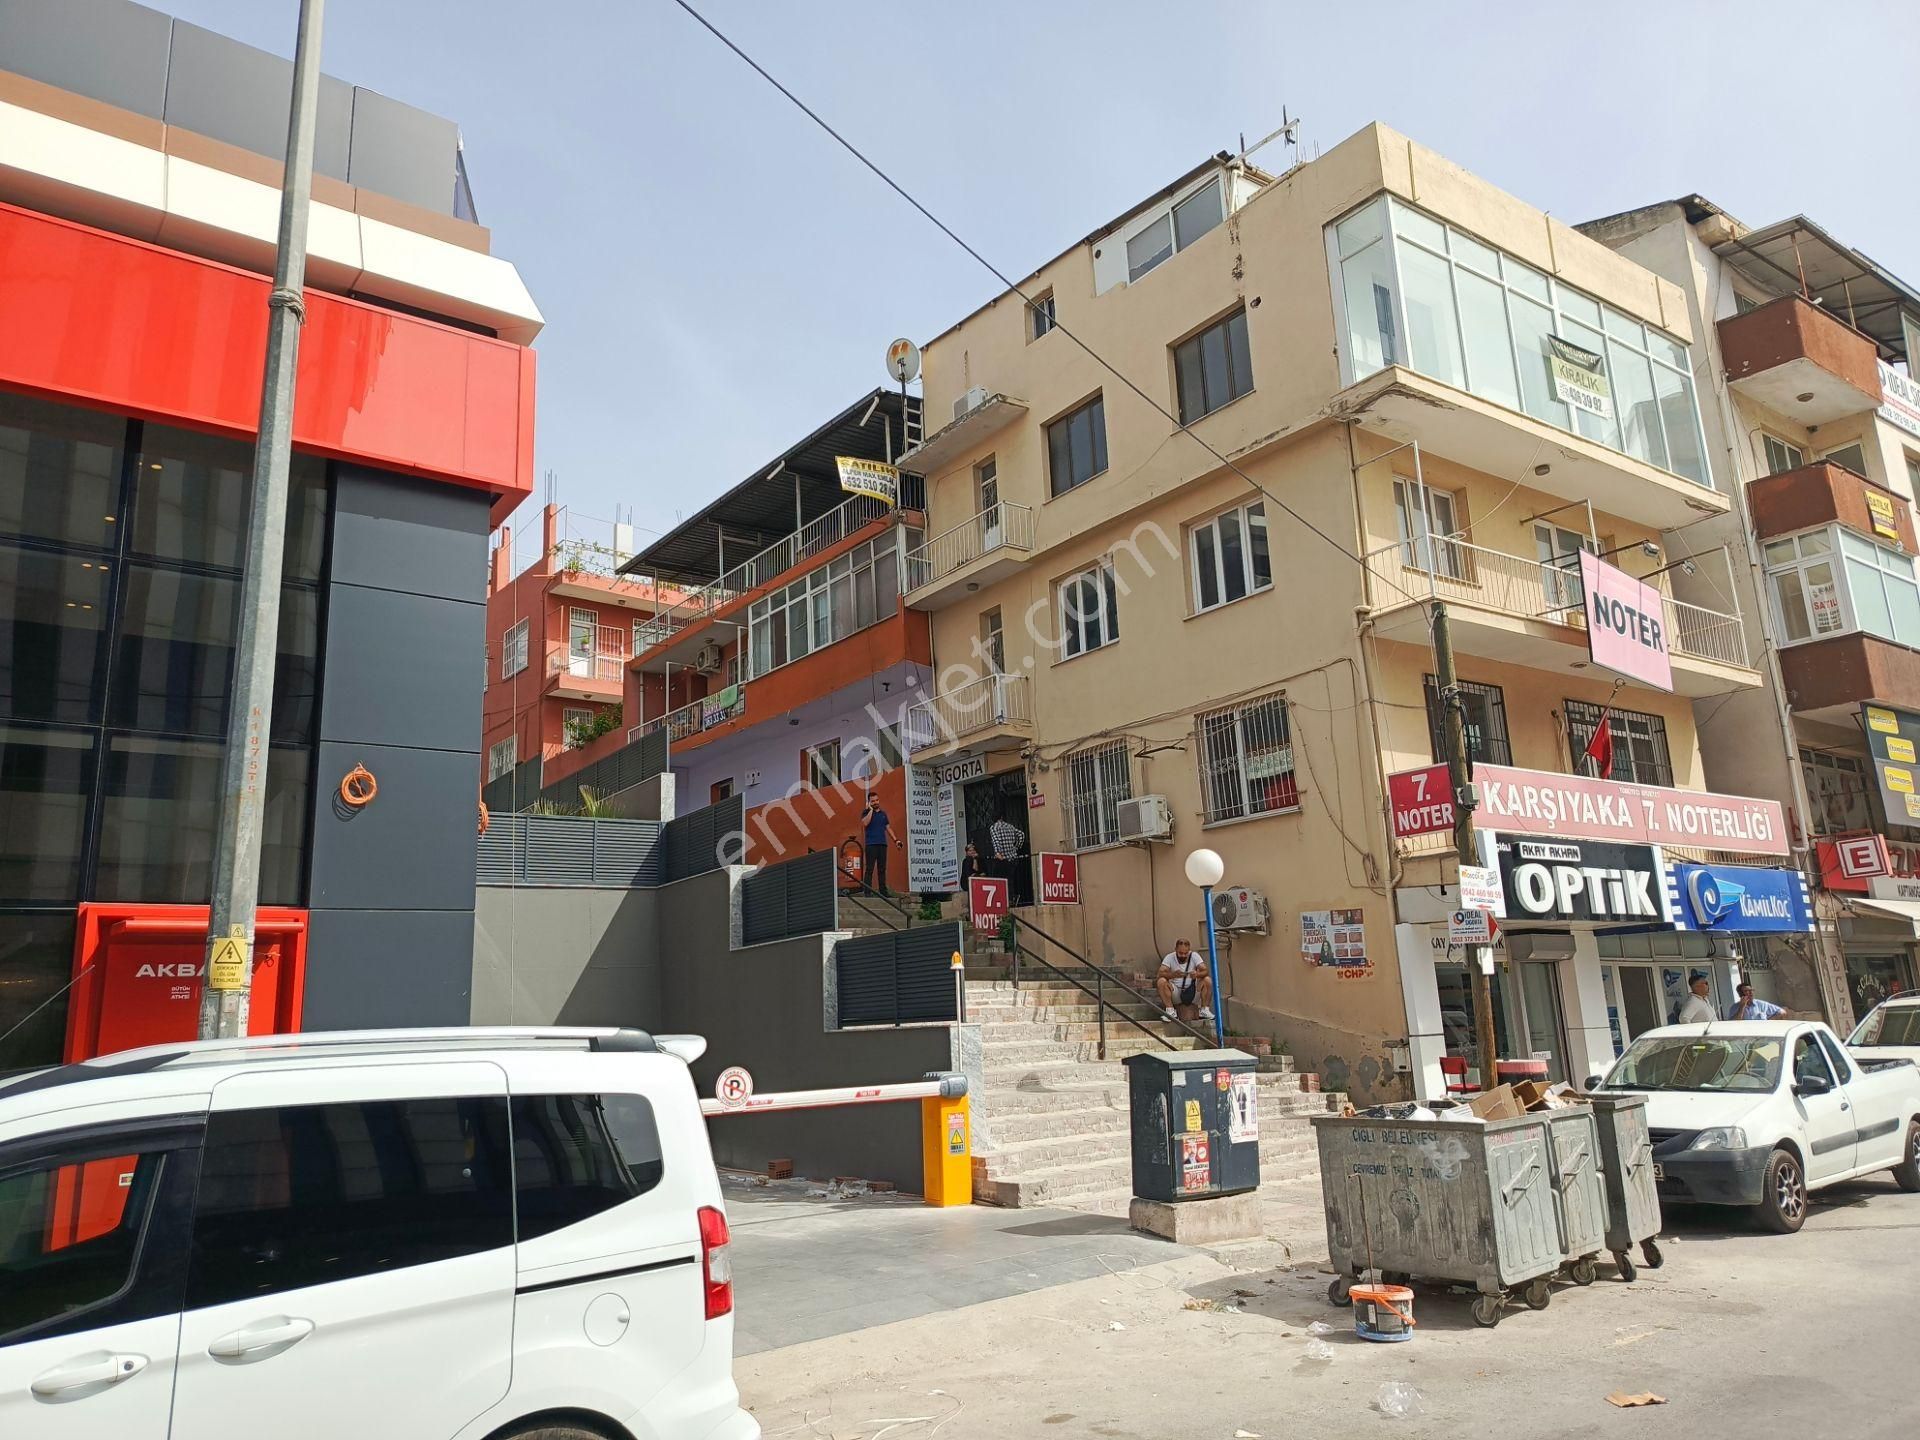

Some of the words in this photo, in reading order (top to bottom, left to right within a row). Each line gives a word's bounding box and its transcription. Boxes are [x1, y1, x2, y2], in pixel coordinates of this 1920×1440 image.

[1813, 600, 1838, 611] SATIL
[1593, 591, 1664, 653] NOTER
[1411, 773, 1431, 802] 7.
[1398, 803, 1454, 832] NOTER
[1482, 780, 1633, 829] KARŞIYAKA
[1643, 799, 1660, 831] 7.
[1664, 802, 1773, 841] NOTERLİĞİ
[1522, 844, 1546, 857] AKAY
[1549, 847, 1579, 859] AKHAN
[1053, 859, 1065, 879] 7.
[982, 885, 1001, 908] 7.
[1045, 883, 1075, 898] NOTER
